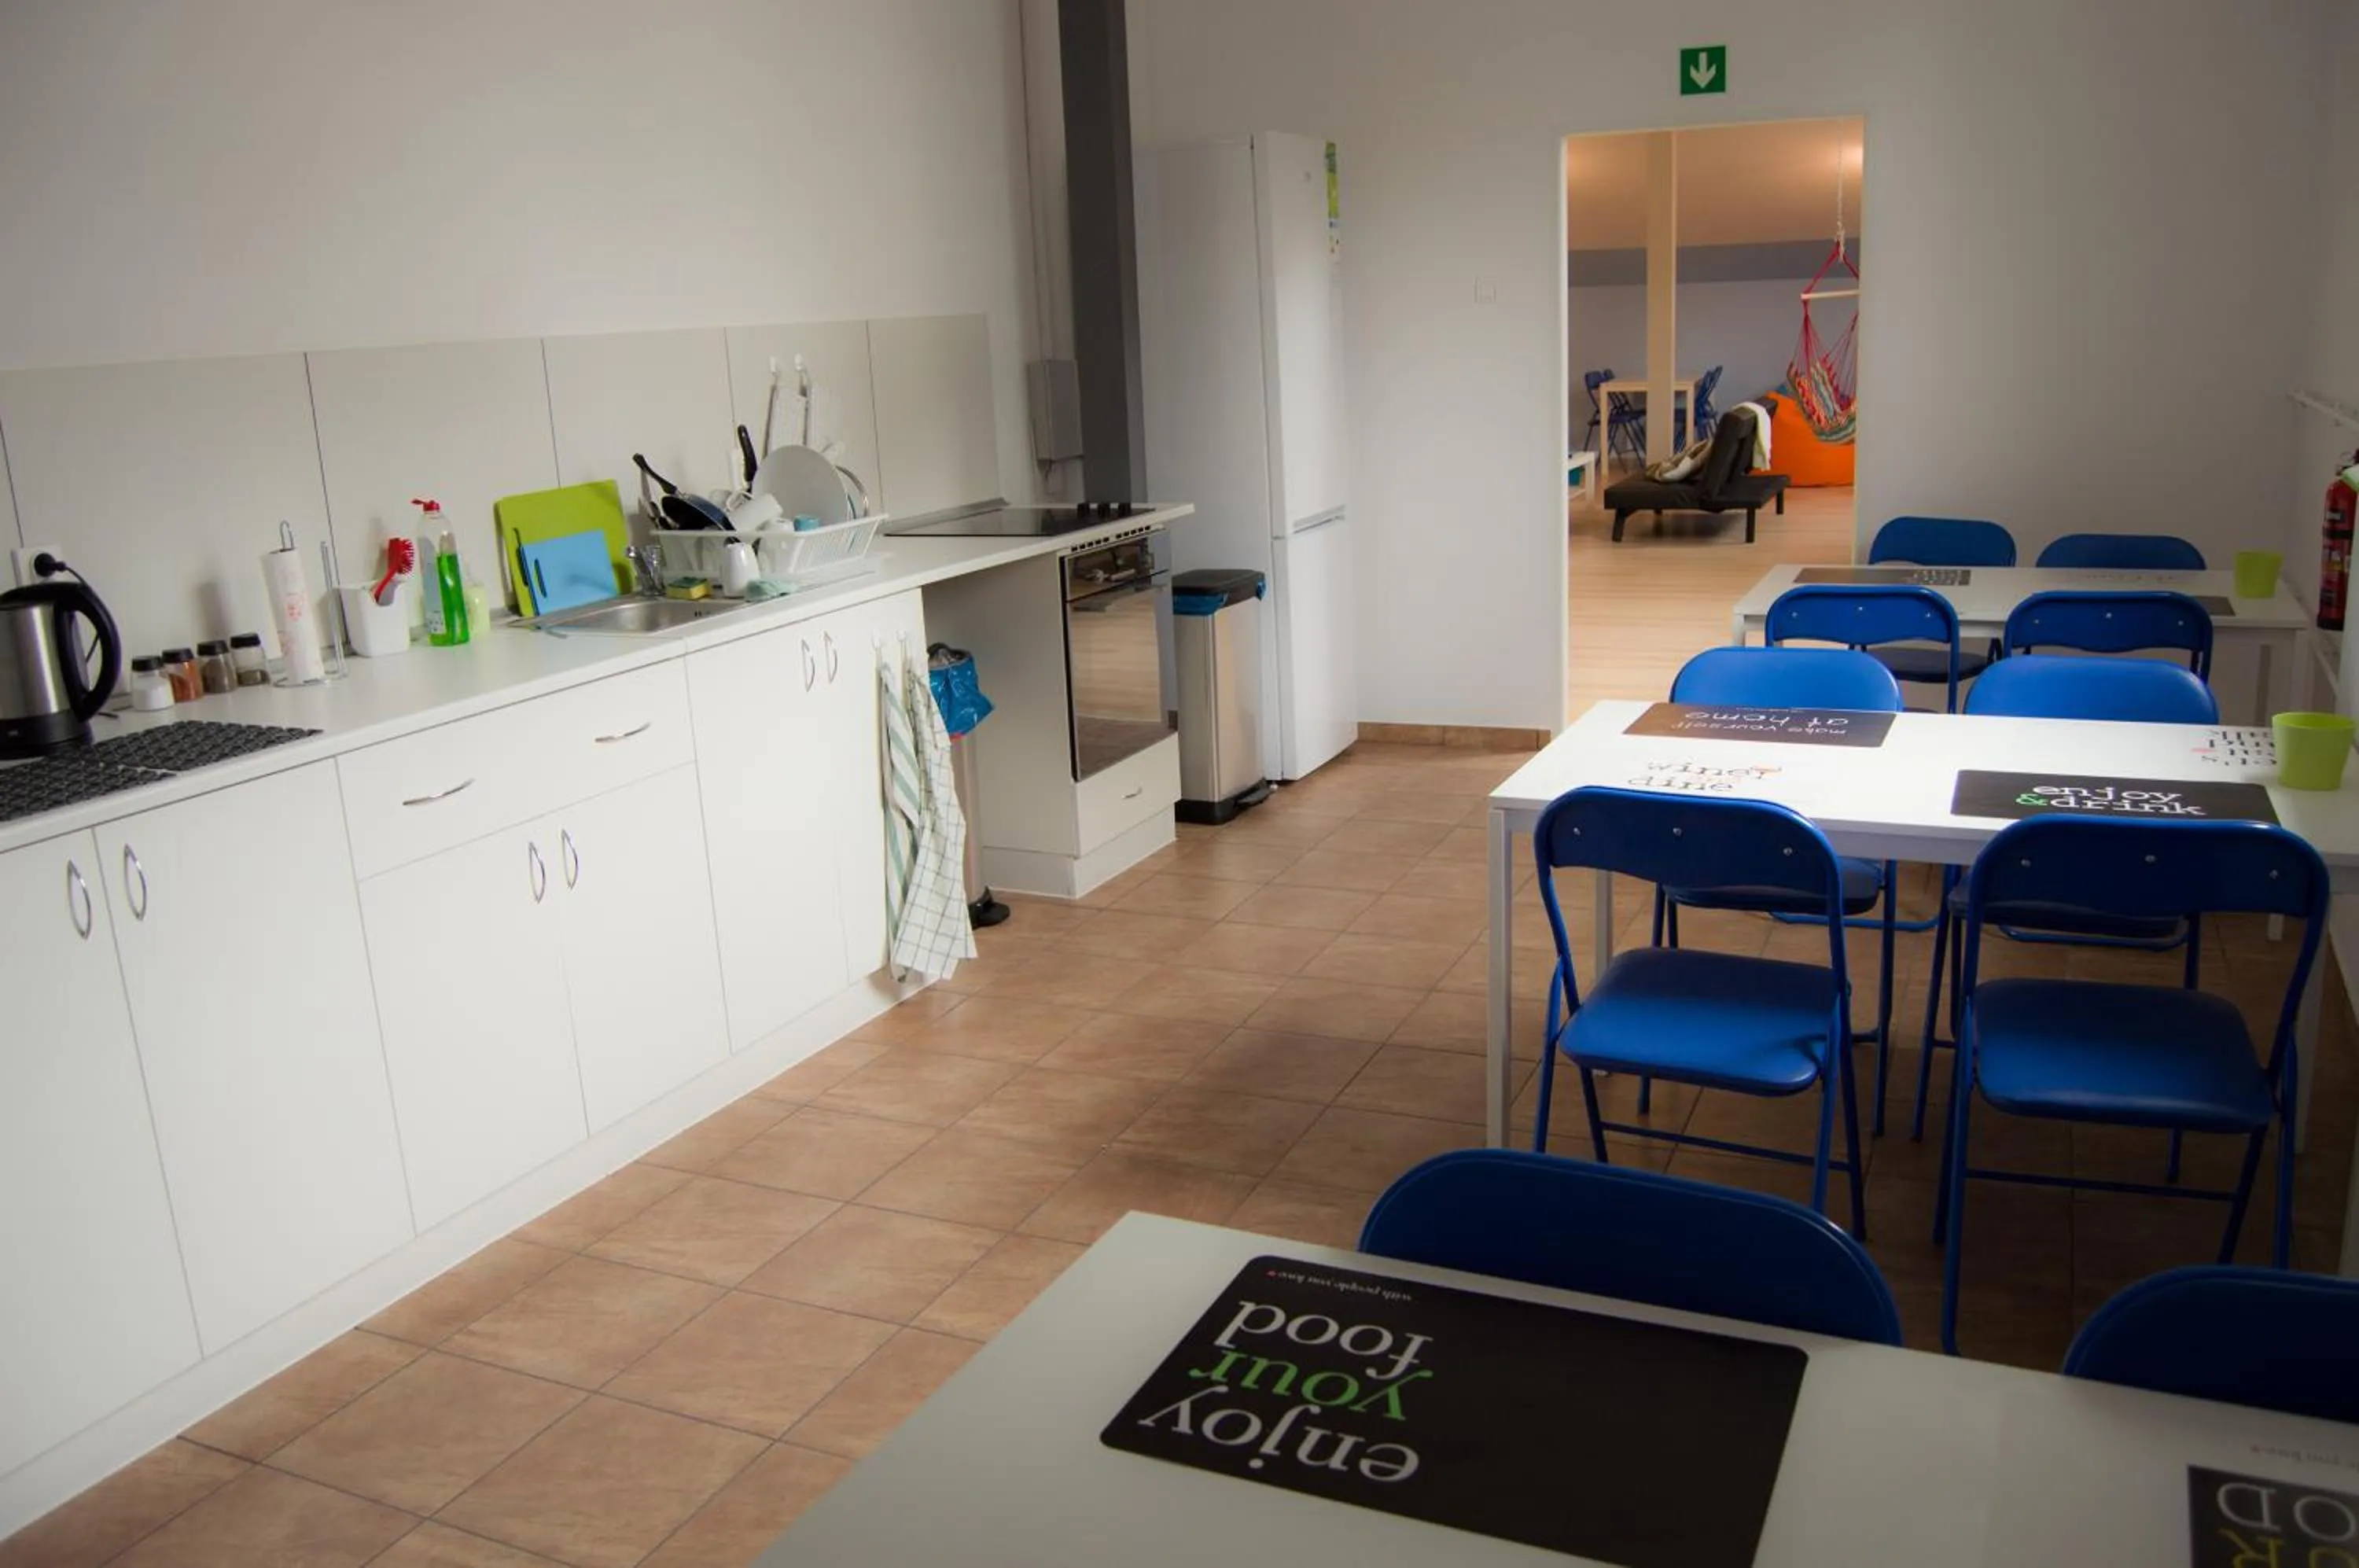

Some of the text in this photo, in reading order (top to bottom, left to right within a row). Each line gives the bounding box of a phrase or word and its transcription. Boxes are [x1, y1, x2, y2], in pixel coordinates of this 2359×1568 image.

[1685, 711, 1849, 727] at home
[1787, 727, 1847, 735] make
[2032, 785, 2182, 803] enjoy
[1213, 1300, 1433, 1380] food
[1187, 1349, 1433, 1421] your
[1137, 1384, 1420, 1482] enjoy
